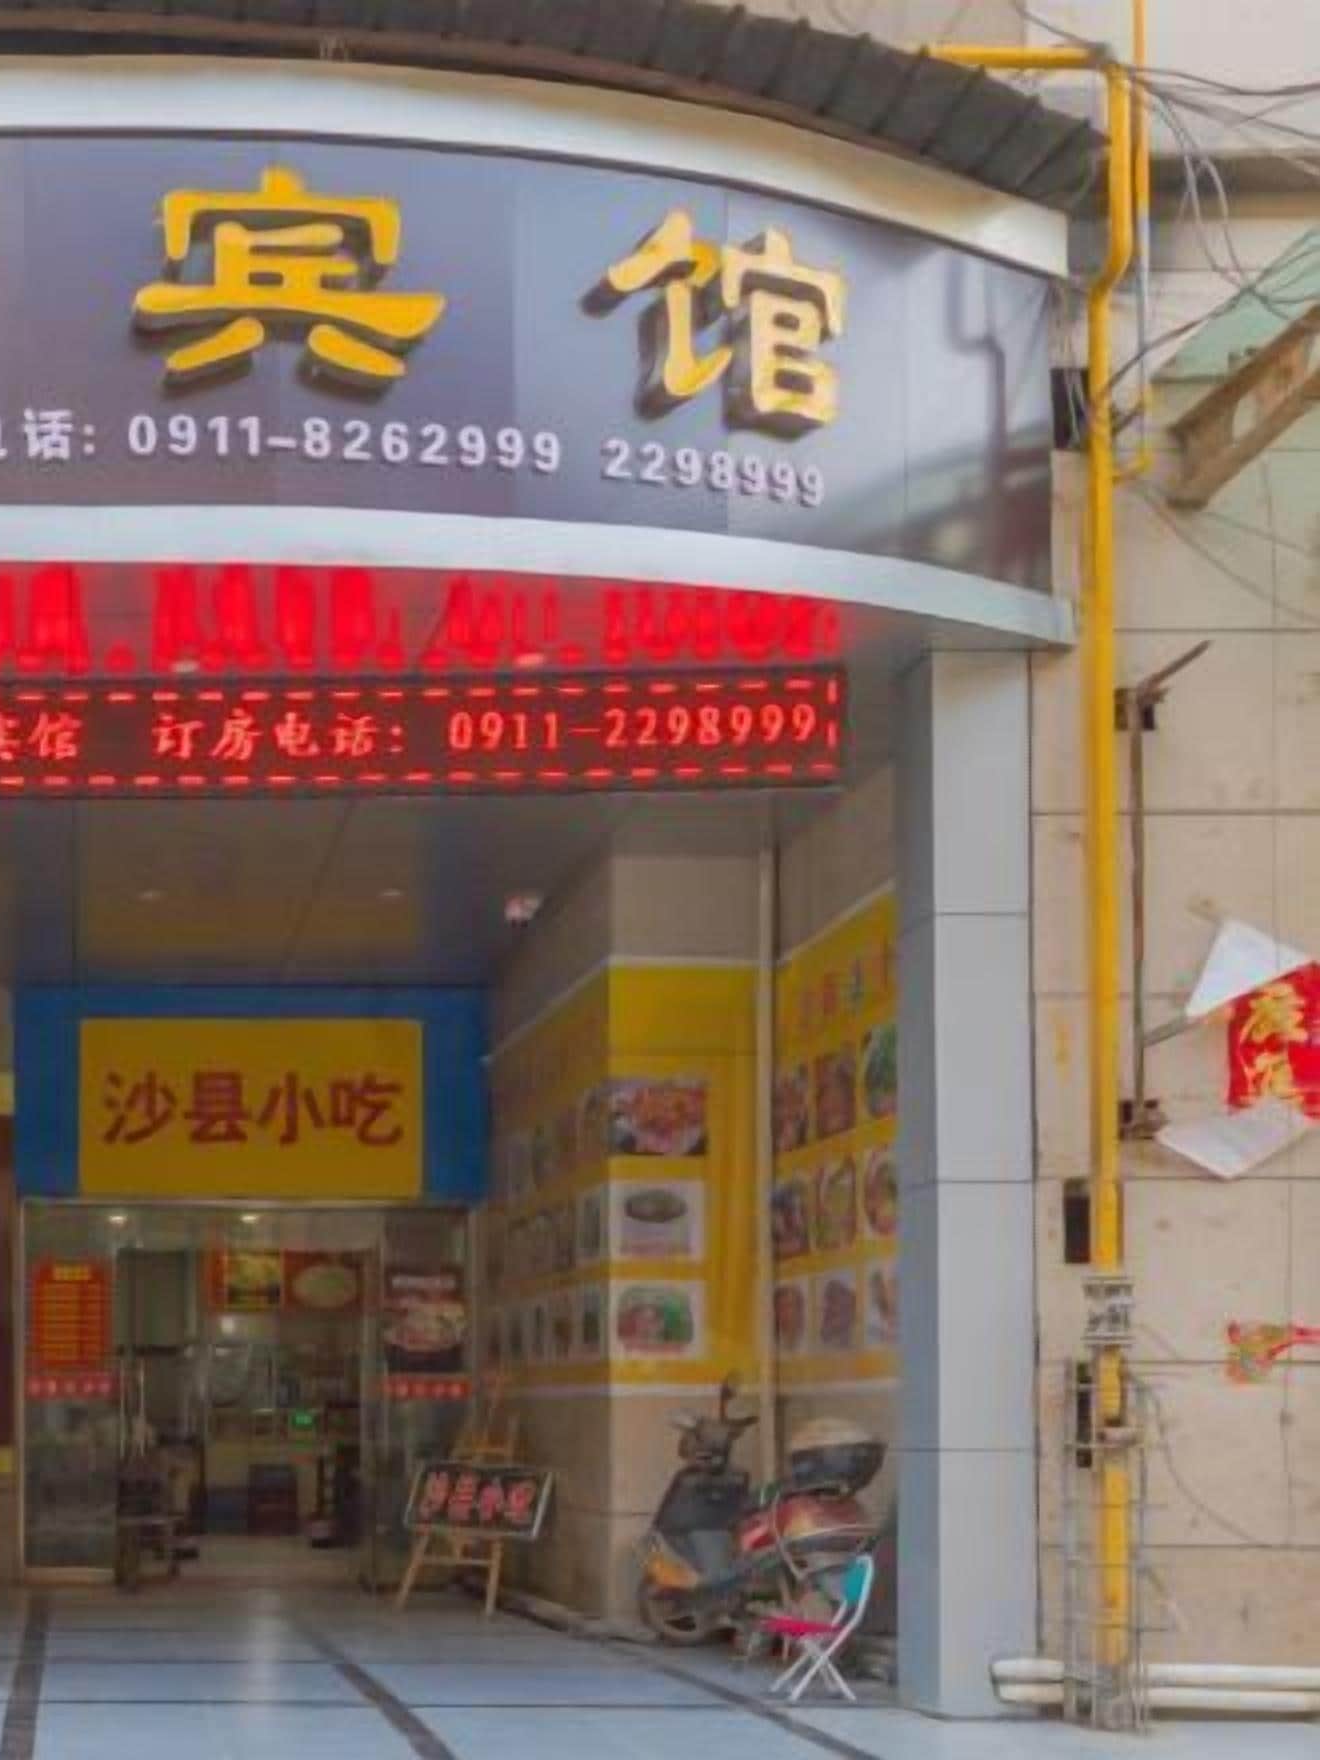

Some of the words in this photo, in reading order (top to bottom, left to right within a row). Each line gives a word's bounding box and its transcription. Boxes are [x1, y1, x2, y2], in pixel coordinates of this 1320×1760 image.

[128, 411, 562, 472] 0911-8262999
[604, 437, 828, 507] 2298999
[151, 711, 407, 761] 订房电话：
[447, 703, 817, 754] 0911-2298999
[101, 1070, 405, 1146] 沙县小吃
